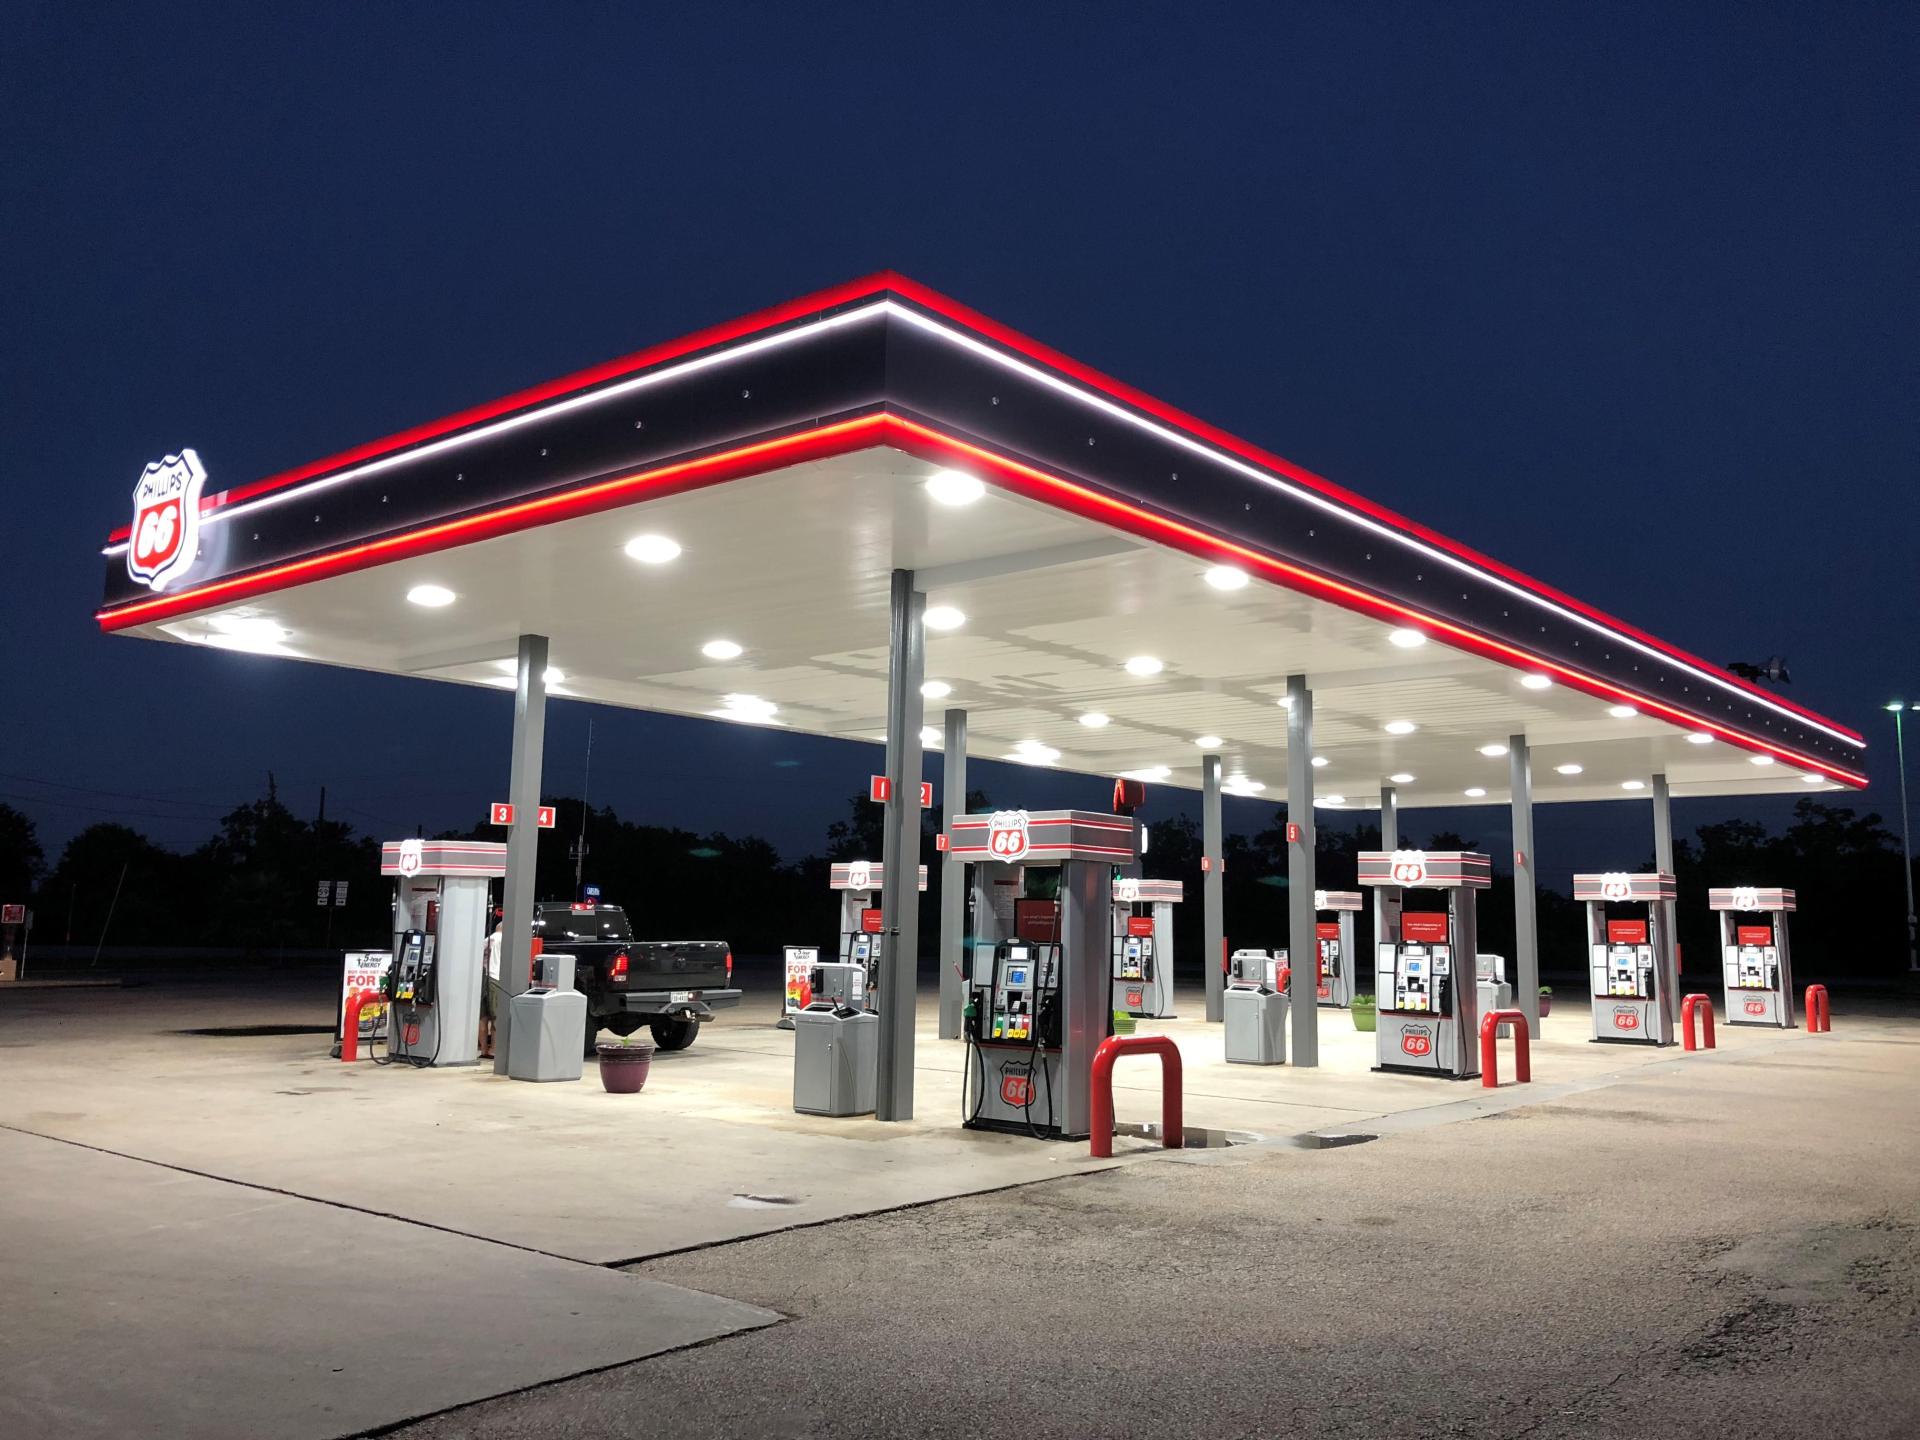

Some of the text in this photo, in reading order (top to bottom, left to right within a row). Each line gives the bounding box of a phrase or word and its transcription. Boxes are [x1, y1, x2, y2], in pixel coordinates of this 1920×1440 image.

[143, 471, 182, 498] PHILLIPS
[137, 505, 178, 559] 66
[499, 807, 507, 821] 3
[540, 810, 548, 824] 4
[993, 818, 1022, 829] PHILLIPS
[1290, 826, 1296, 839] 5
[941, 837, 946, 849] 7
[995, 831, 1021, 852] 66
[1397, 865, 1420, 880] 66
[788, 965, 807, 974] FOR
[347, 975, 376, 986] FOR
[1748, 1003, 1762, 1013] 66
[1618, 1015, 1634, 1026] 66
[1405, 1028, 1428, 1036] PHILLIPS
[1406, 1037, 1426, 1050] 66
[1004, 1066, 1031, 1076] PHILLIP
[1007, 1081, 1030, 1099] 66
